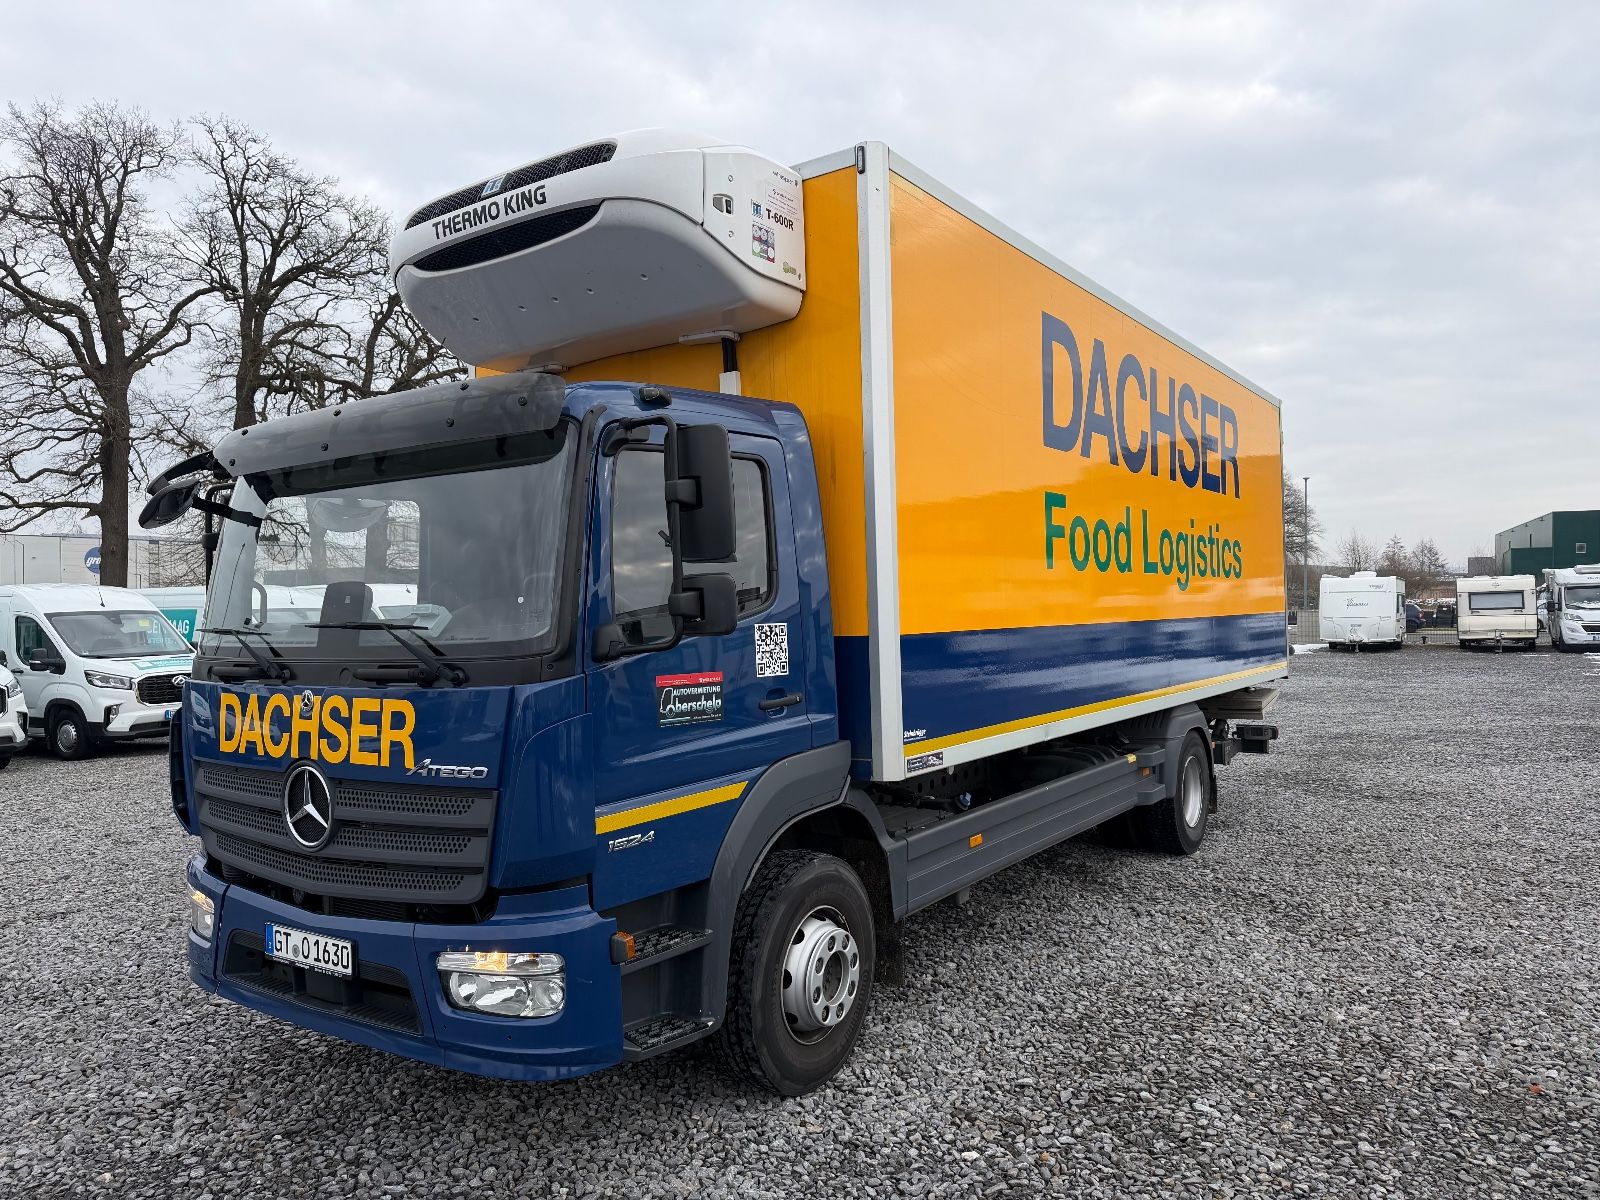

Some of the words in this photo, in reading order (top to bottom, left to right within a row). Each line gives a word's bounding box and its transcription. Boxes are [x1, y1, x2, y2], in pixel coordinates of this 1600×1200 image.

[432, 201, 501, 240] THERMO
[503, 184, 547, 217] KING
[765, 207, 794, 232] T-600R
[1041, 310, 1241, 500] DACHSER
[1044, 490, 1132, 574] Food
[1141, 508, 1243, 592] Logistics
[672, 685, 721, 697] AUTOVERMIETUNG
[219, 692, 416, 769] DACHSER
[405, 758, 489, 779] ATEGO
[607, 830, 655, 854] 1524
[274, 929, 291, 955] GT
[313, 939, 350, 970] 1630
